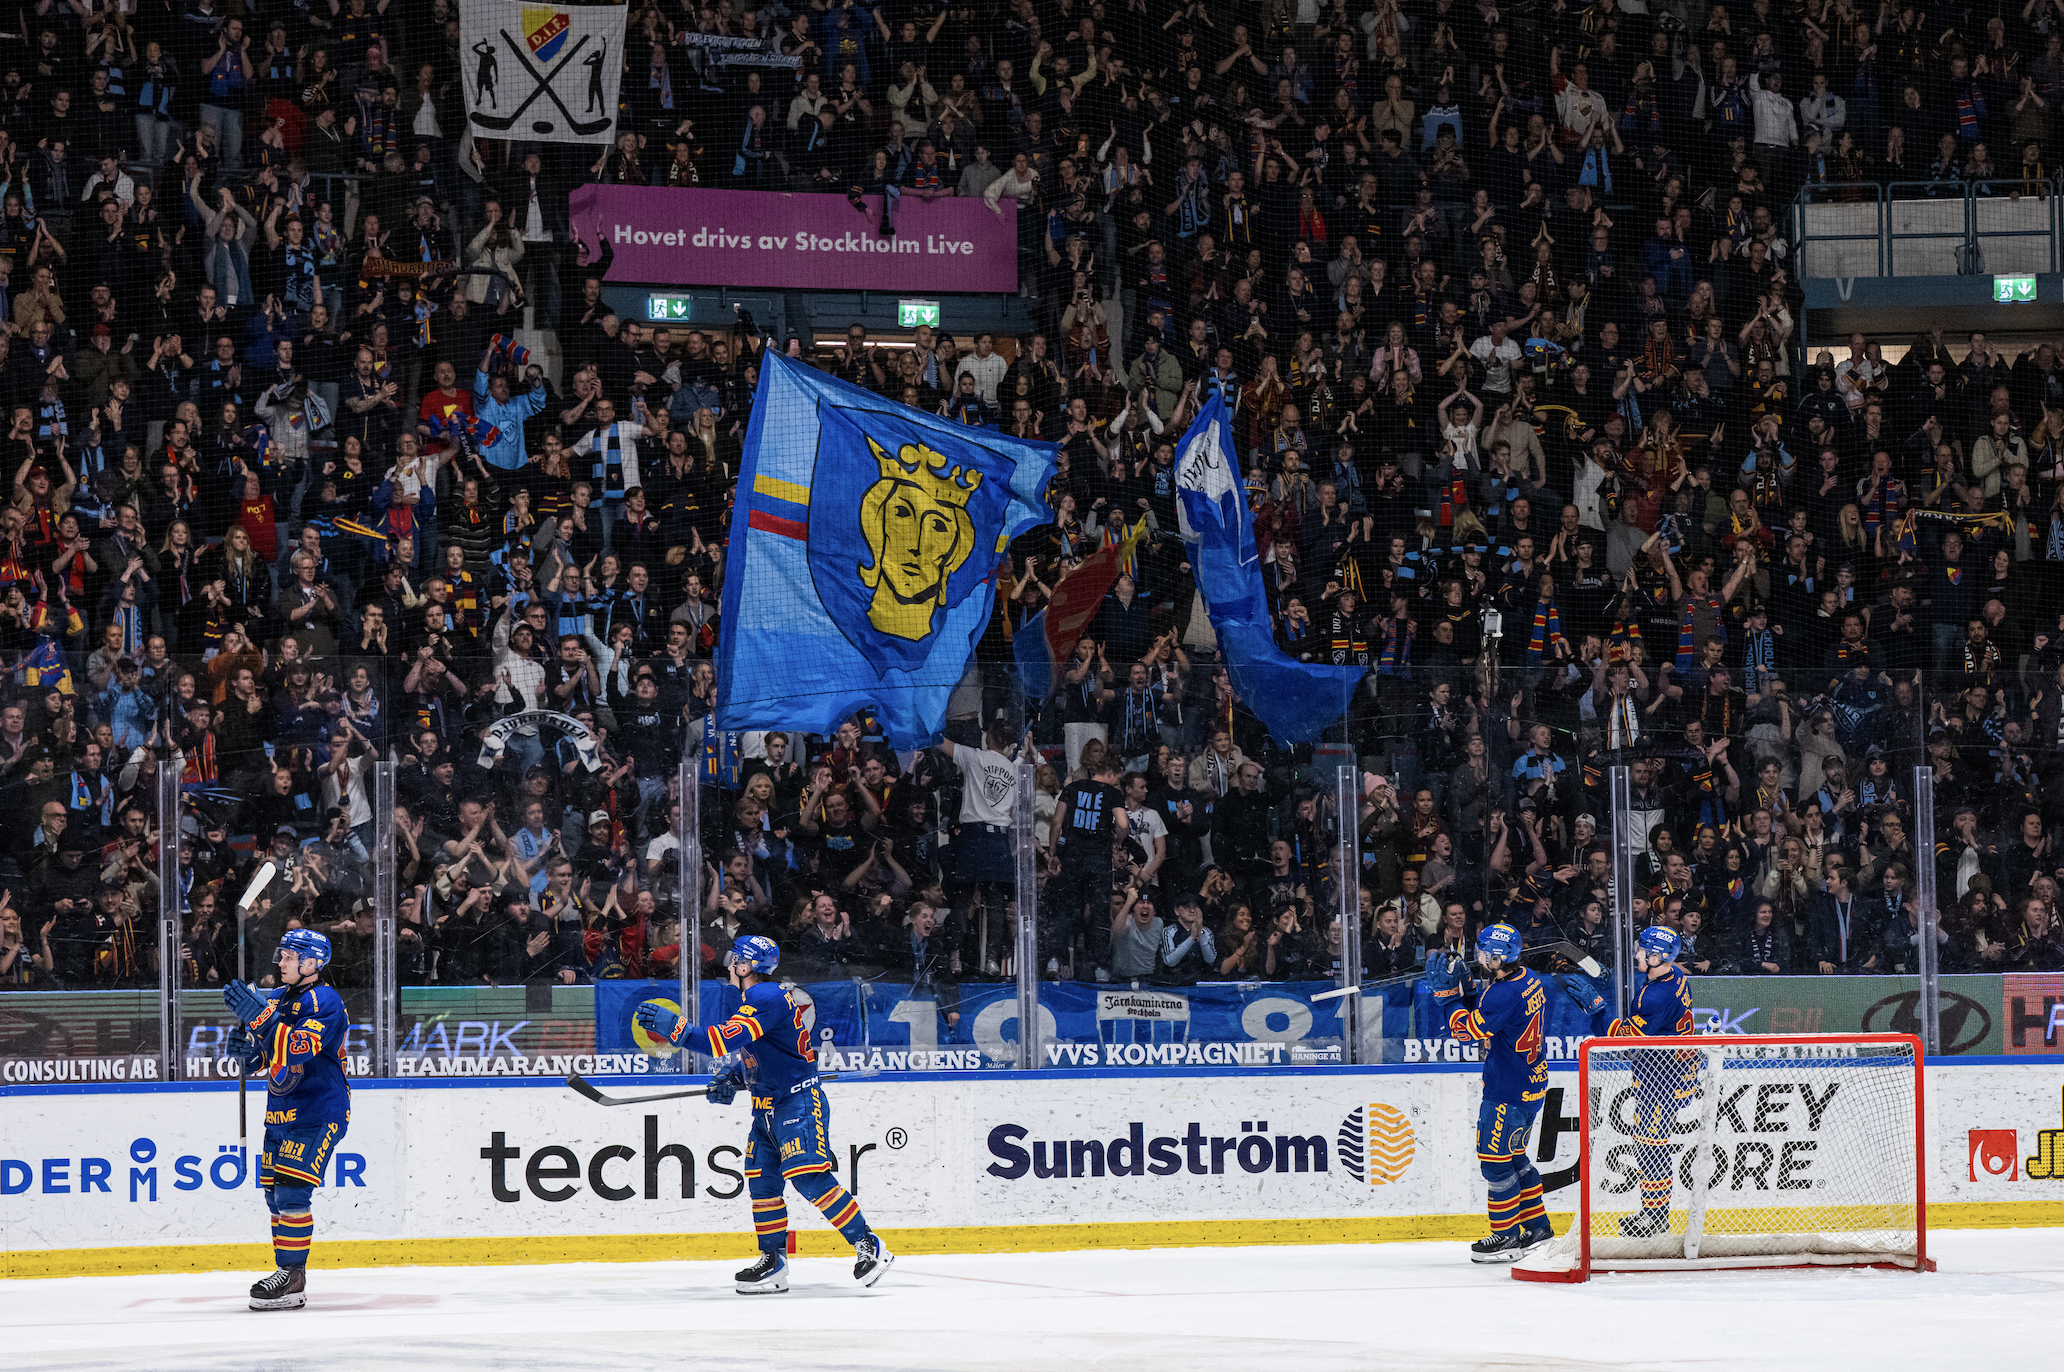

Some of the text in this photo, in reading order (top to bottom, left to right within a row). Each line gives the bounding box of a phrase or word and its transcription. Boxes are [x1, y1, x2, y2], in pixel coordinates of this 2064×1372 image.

[614, 225, 974, 255] Hovet drivs av Stockholm Live
[988, 780, 1008, 793] 467
[1073, 808, 1101, 830] DIF
[1104, 995, 1183, 1010] Järnkaminerna
[818, 1047, 981, 1071] ARÄNGENS
[1046, 1043, 1285, 1065] VVS KOMPAGNIET
[1292, 1052, 1326, 1061] HANINGE
[3, 1059, 125, 1081] CONSULTING
[186, 1057, 212, 1077] HT
[653, 1065, 675, 1074] Måleri
[790, 1076, 819, 1093] CCM
[811, 1088, 827, 1158] Interbus
[310, 1122, 339, 1175] Interb
[480, 1115, 877, 1203] techsr
[986, 1121, 1328, 1180] Sundström
[174, 1145, 366, 1191] SÖR
